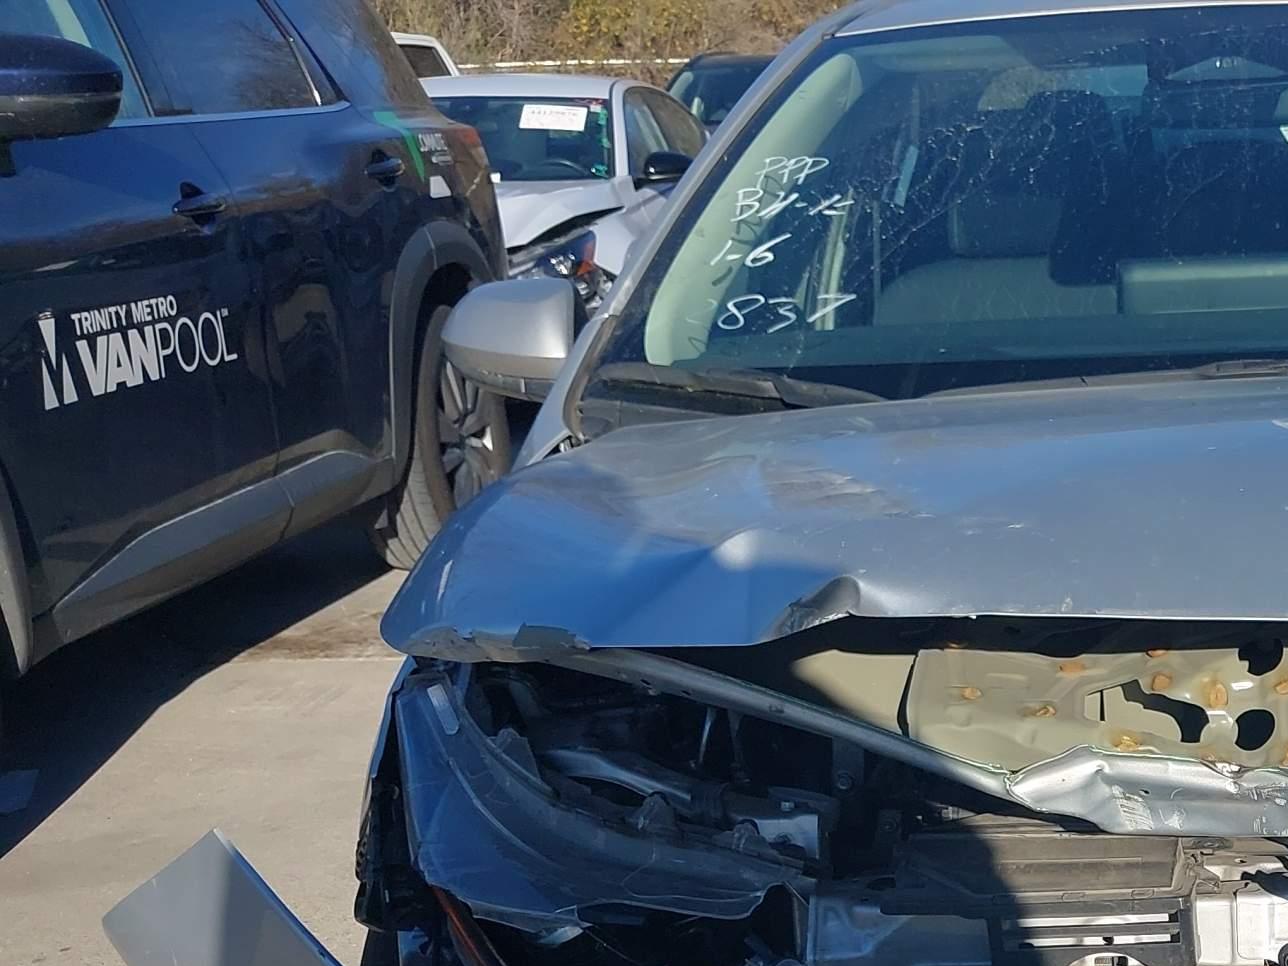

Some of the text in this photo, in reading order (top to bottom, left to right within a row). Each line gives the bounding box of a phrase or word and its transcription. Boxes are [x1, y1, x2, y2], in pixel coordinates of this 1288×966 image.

[71, 295, 177, 336] TRINITY METRO
[717, 294, 857, 334] 837
[75, 310, 239, 397] VANPOOL
